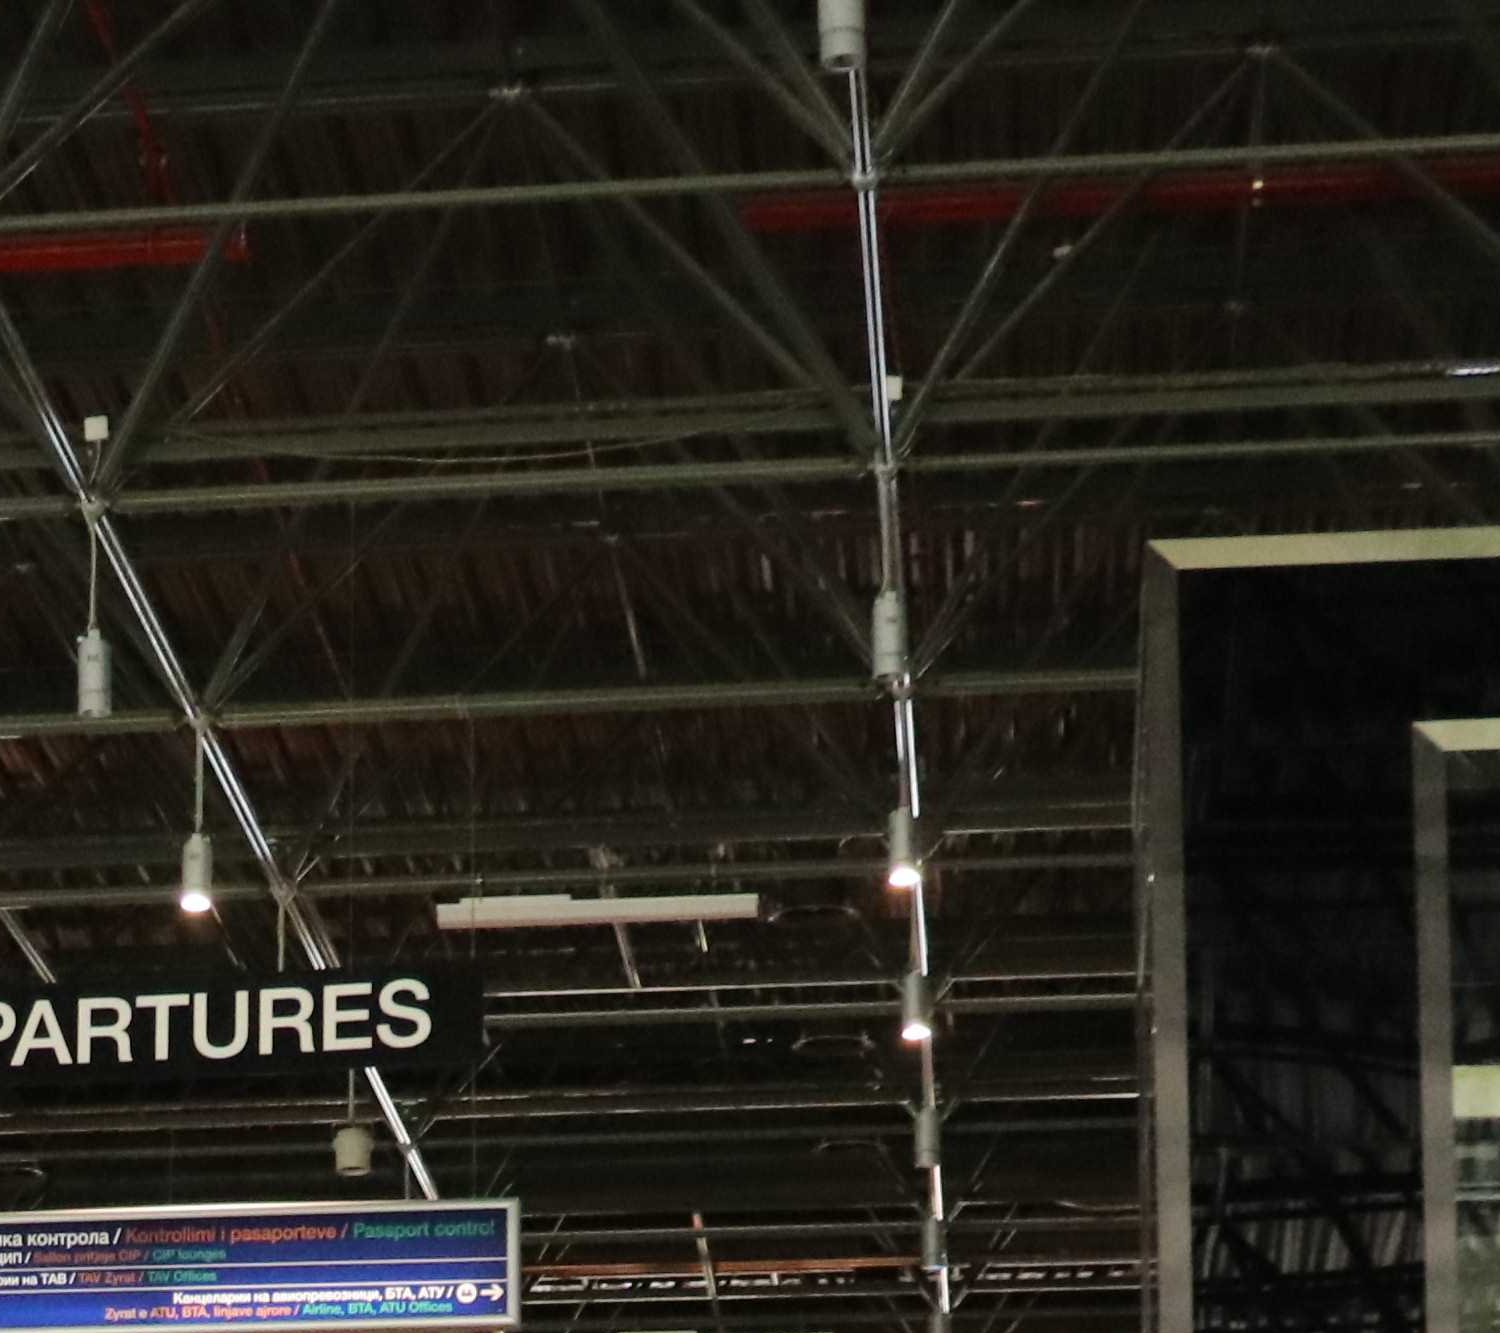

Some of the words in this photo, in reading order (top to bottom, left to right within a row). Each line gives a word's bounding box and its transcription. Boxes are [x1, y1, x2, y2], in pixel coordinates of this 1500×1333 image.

[27, 1228, 110, 1249] контрола
[113, 1227, 122, 1245] /
[126, 1226, 216, 1244] Kontrollimi
[231, 1224, 337, 1244] pasaporteve
[353, 1221, 430, 1242] Passport
[433, 1219, 495, 1237] control
[22, 1275, 38, 1285] на
[40, 1272, 66, 1285] ТАВ
[79, 1273, 100, 1284] TAV
[148, 1271, 170, 1282] TAV
[173, 1270, 218, 1282] Offices
[173, 1290, 251, 1306] Канцеларии
[253, 1291, 271, 1303] на
[150, 1306, 179, 1320] ATU,
[181, 1305, 211, 1319] BTA,
[302, 1302, 345, 1316] Airline,
[348, 1302, 377, 1316] BTA,
[380, 1300, 406, 1314] ATU
[408, 1299, 453, 1314] Offices
